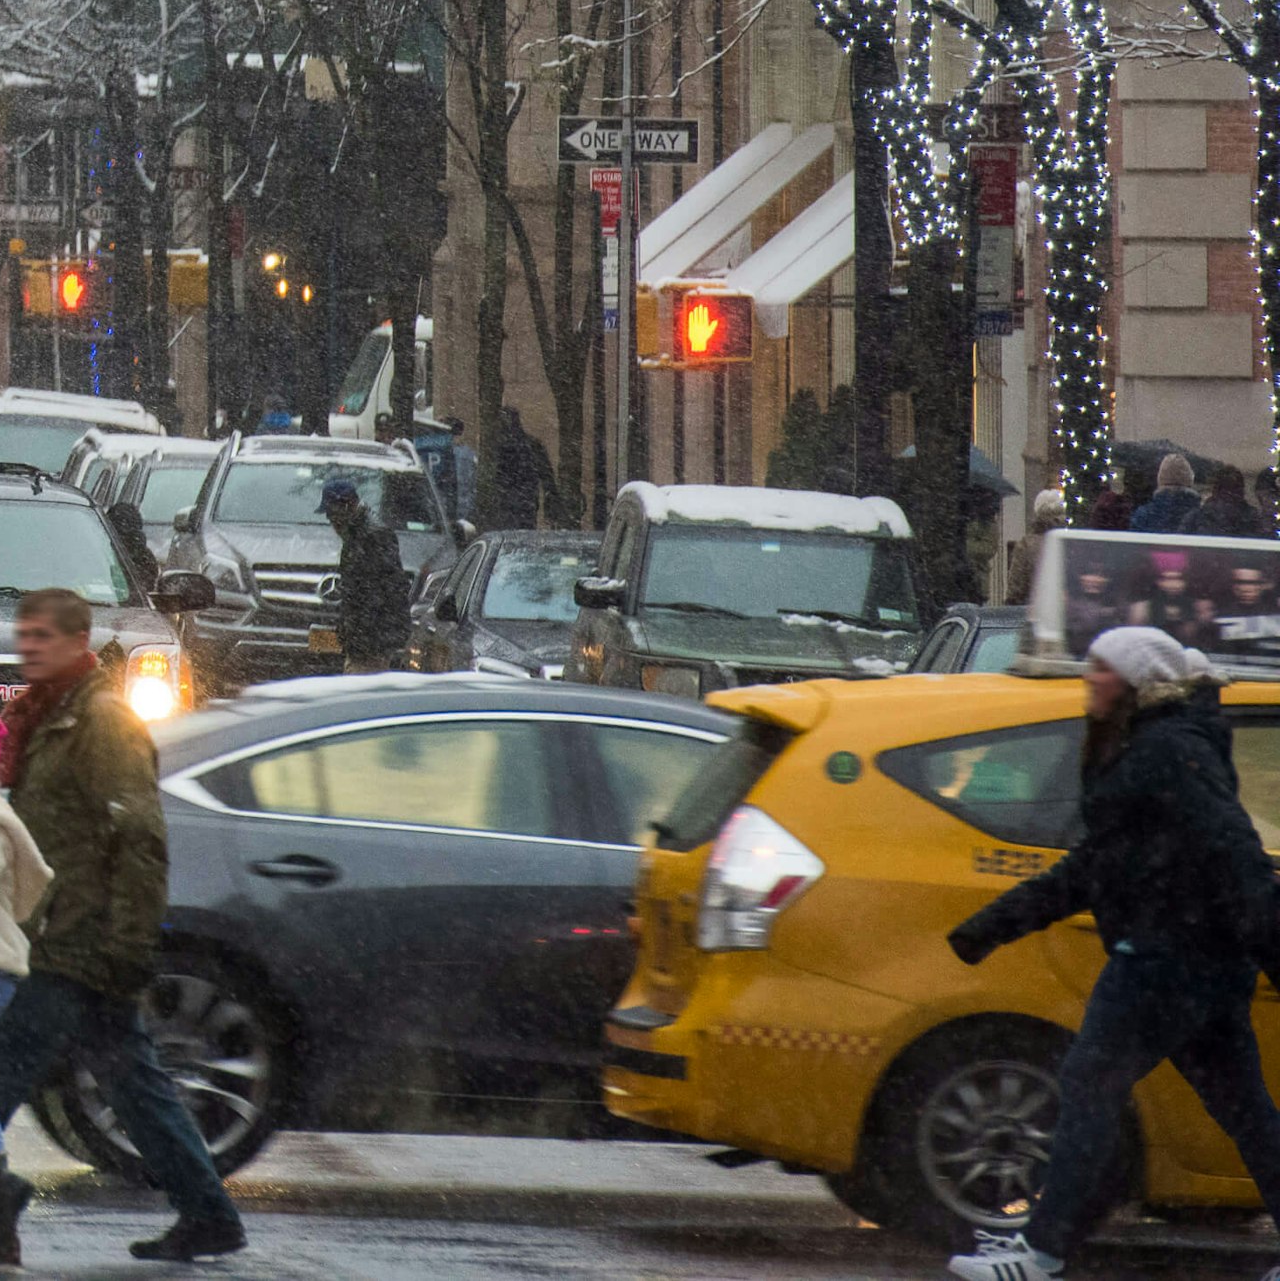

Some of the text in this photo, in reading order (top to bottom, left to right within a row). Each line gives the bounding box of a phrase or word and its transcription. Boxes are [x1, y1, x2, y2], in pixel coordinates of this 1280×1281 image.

[977, 111, 999, 138] St
[579, 130, 680, 151] ONE WAY
